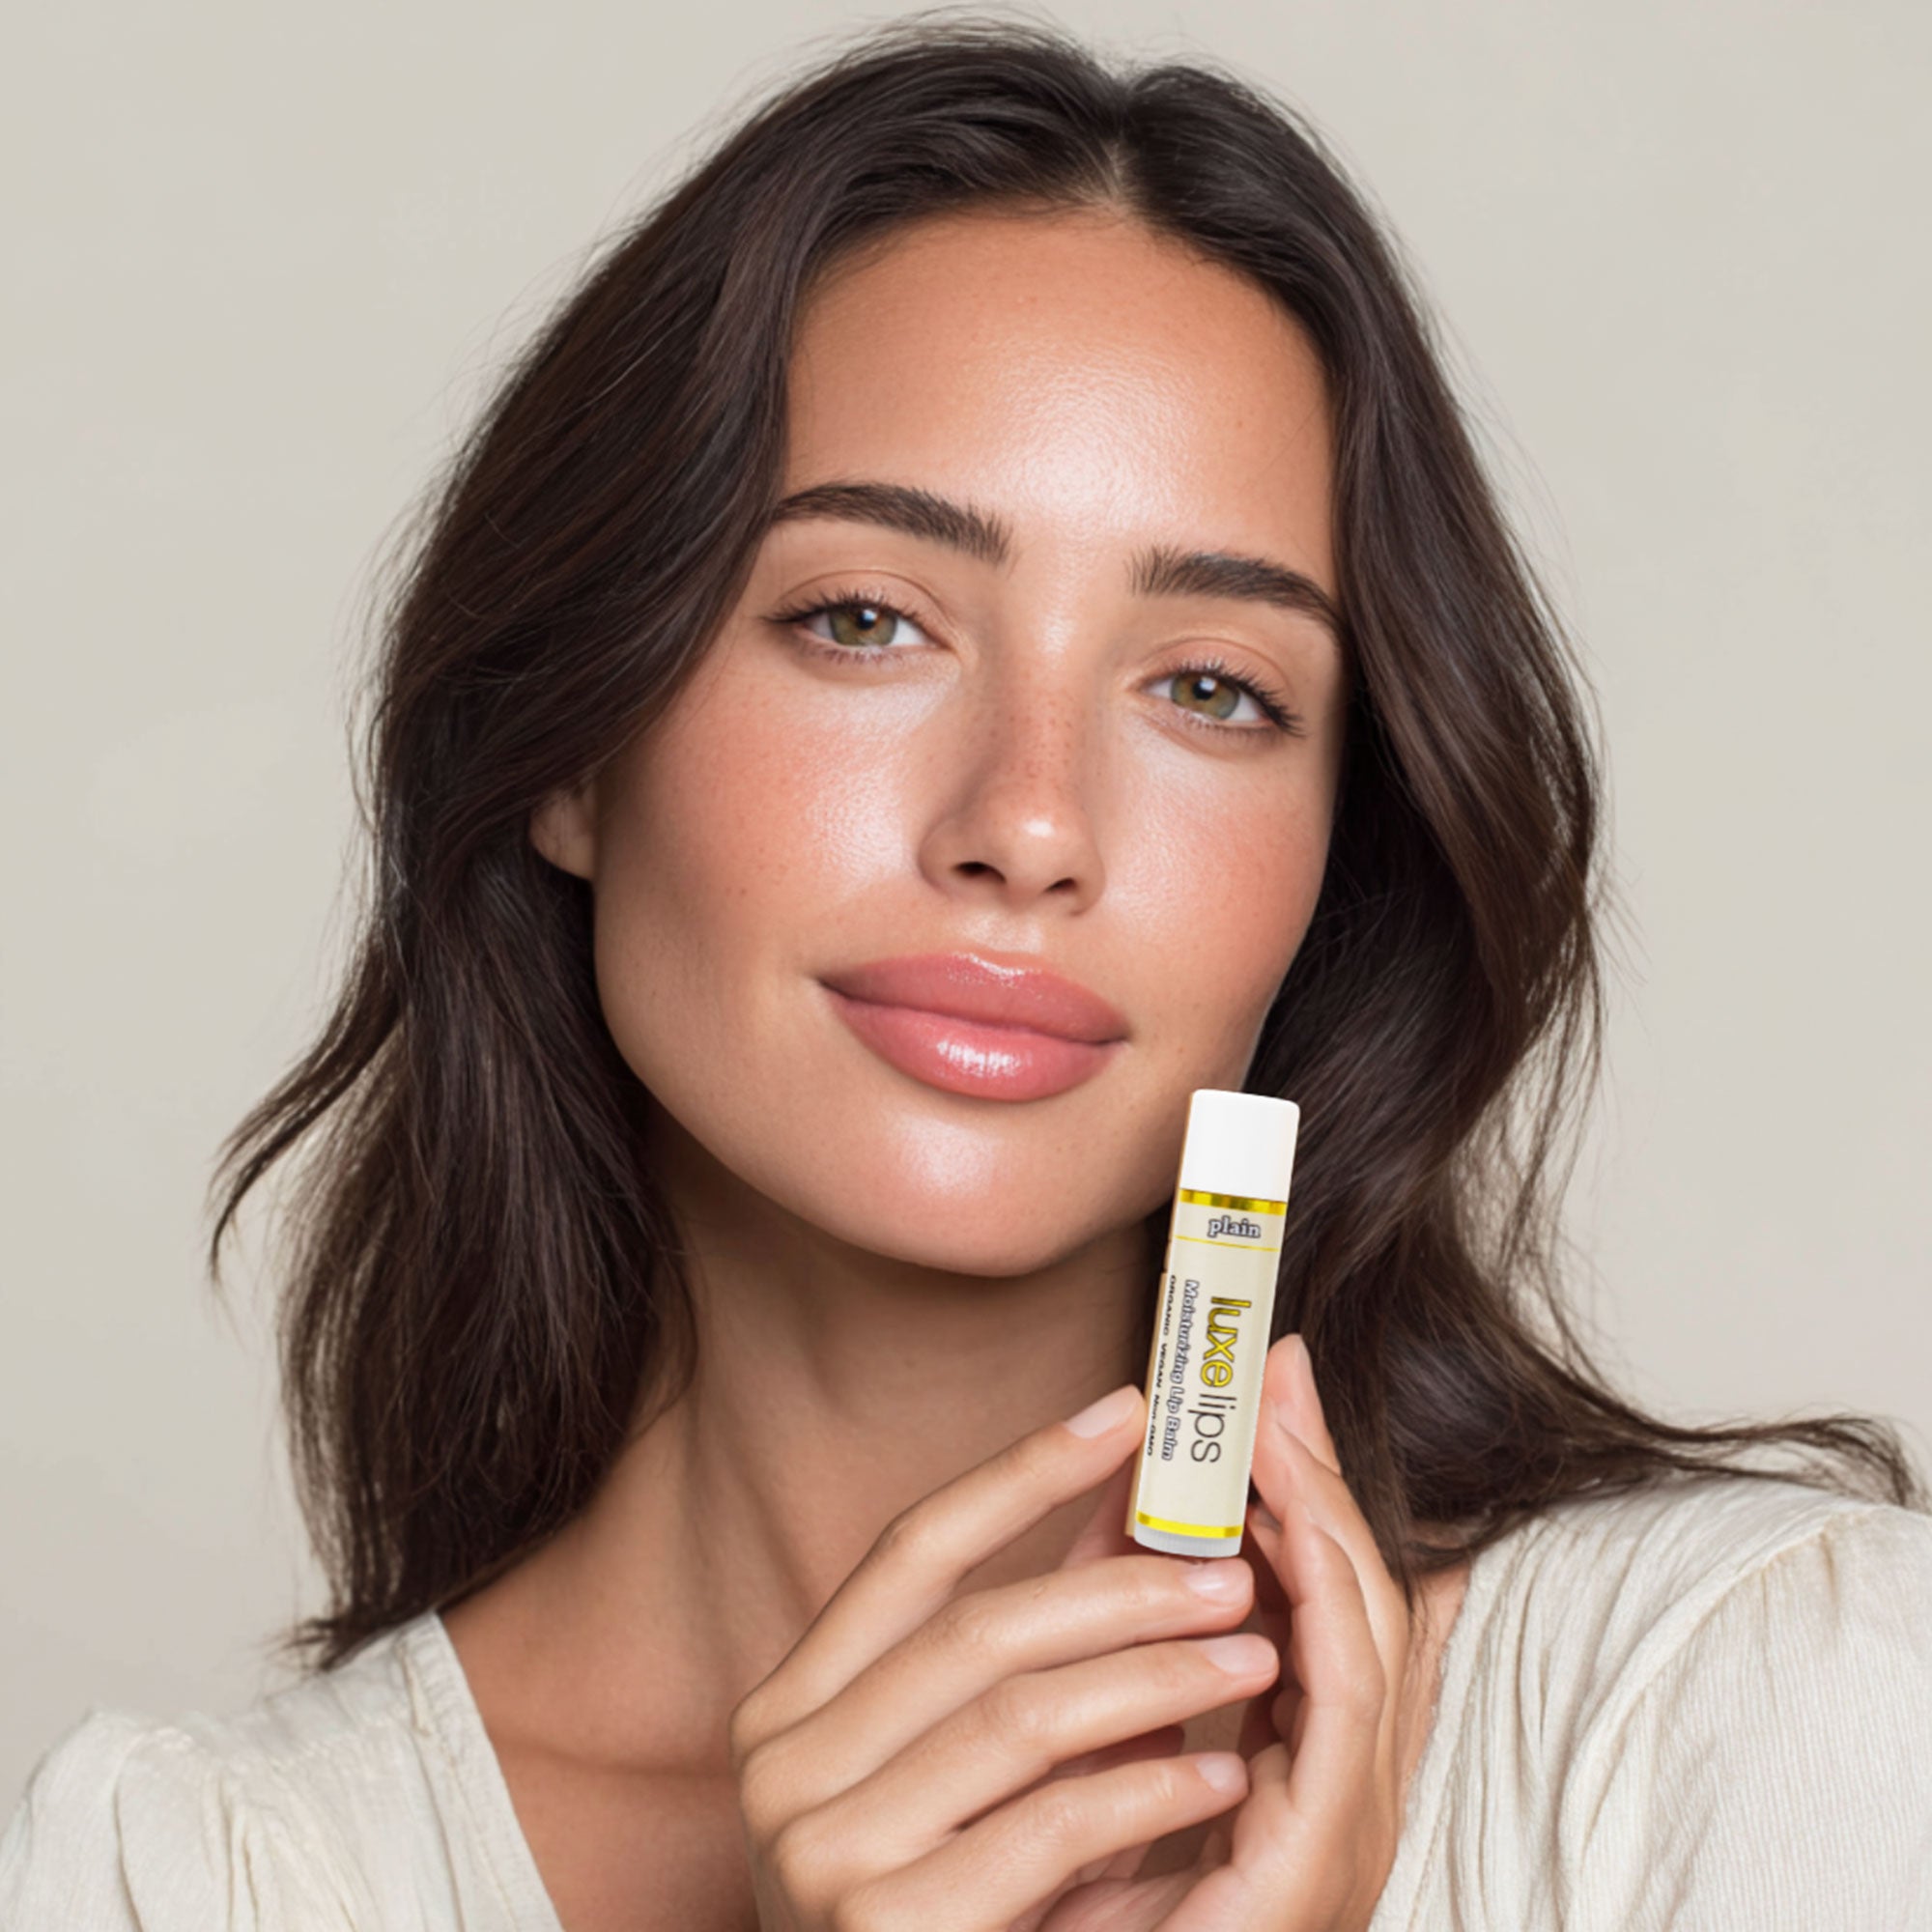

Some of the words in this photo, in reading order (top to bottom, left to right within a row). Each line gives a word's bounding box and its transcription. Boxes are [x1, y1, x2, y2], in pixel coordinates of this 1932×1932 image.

[1207, 1214, 1262, 1238] plain
[1163, 1274, 1177, 1336] ORGANIC
[1170, 1279, 1200, 1384] Moisturizing
[1200, 1295, 1252, 1387] luxe
[1166, 1385, 1185, 1414] Lip
[1187, 1393, 1237, 1463] lips
[1161, 1415, 1181, 1461] Balm
